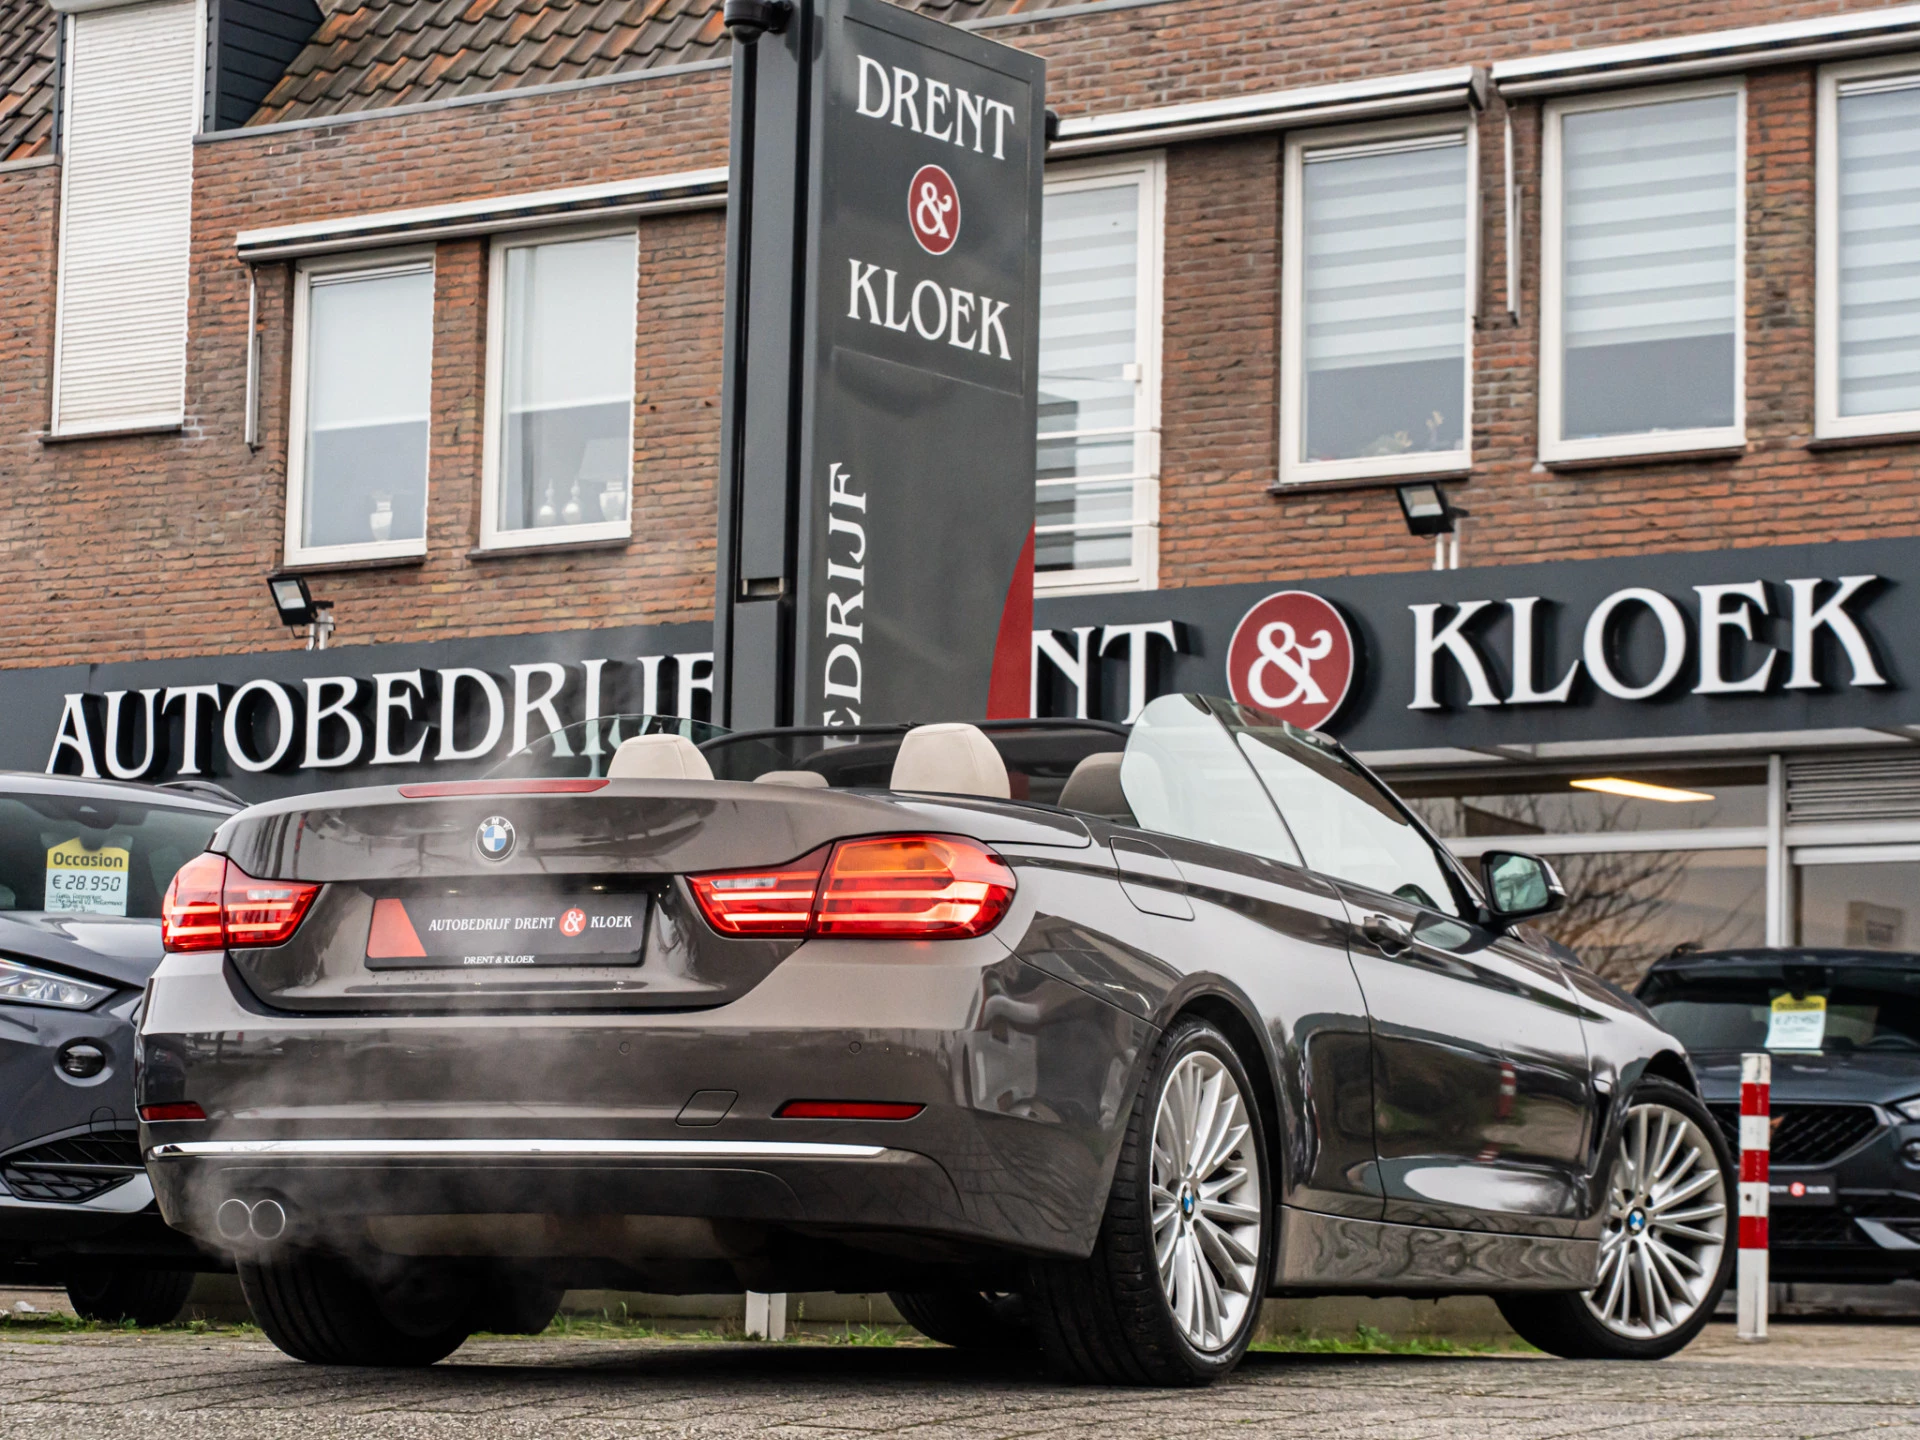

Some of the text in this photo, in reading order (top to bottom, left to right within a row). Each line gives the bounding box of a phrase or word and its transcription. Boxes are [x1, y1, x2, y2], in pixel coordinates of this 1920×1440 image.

[855, 54, 1015, 161] DRENT
[916, 181, 953, 239] &
[847, 258, 1012, 361] KLOEK
[1247, 621, 1333, 709] &
[1406, 574, 1888, 710] KLOEK
[53, 851, 123, 868] Occasion
[428, 910, 633, 933] AUTOBEDRIJF DRENT & KLOEK
[463, 954, 536, 965] DRENT & KLOEK
